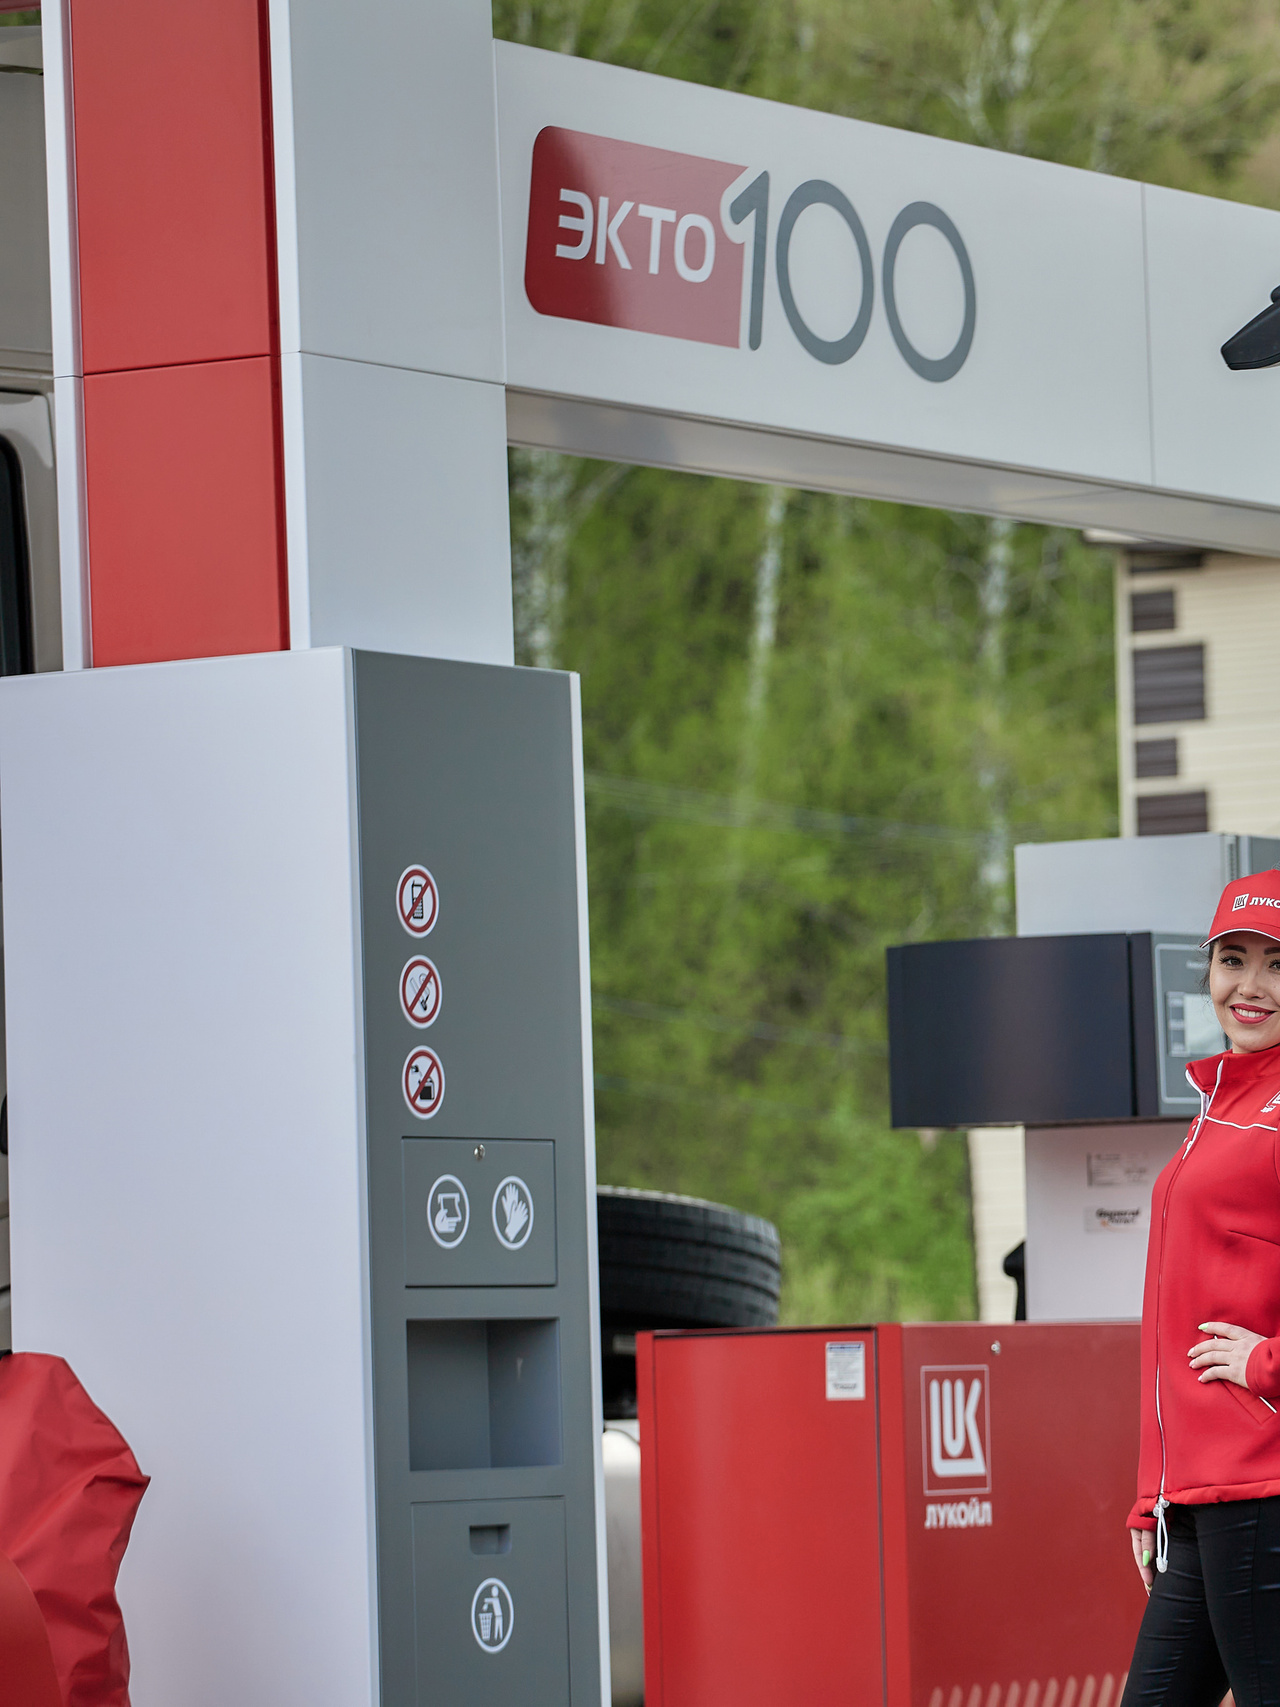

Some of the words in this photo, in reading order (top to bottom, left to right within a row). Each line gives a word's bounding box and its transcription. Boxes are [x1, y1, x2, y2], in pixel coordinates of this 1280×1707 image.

[555, 188, 716, 283] ЭКТО
[730, 170, 976, 382] 100
[924, 1497, 993, 1529] ЛУКОЙЛ
